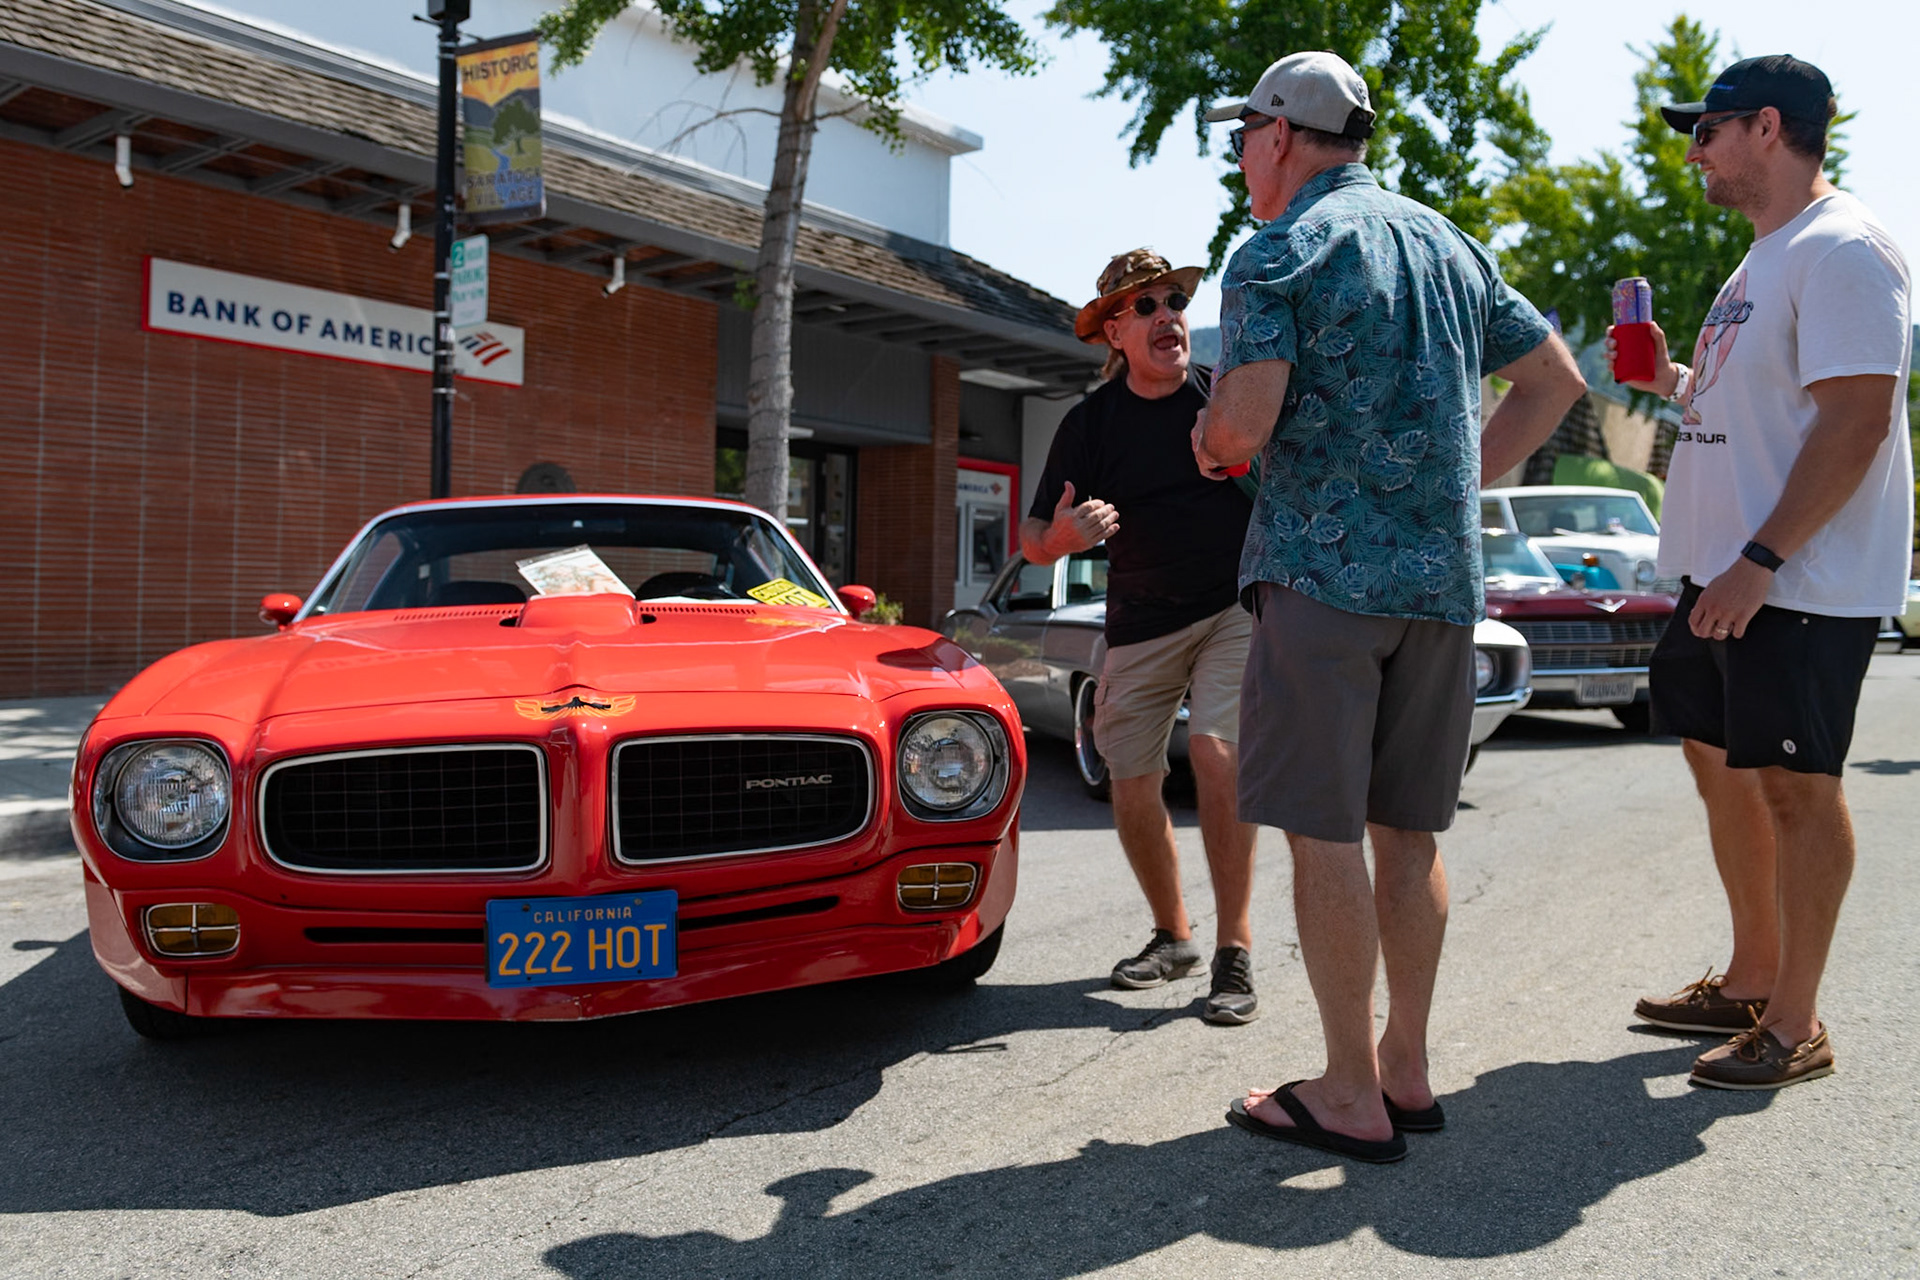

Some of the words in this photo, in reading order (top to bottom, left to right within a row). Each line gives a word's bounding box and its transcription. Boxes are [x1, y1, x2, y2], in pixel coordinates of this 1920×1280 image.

[462, 52, 537, 82] HISTORIC
[454, 245, 463, 265] 2
[167, 290, 261, 328] BANK
[272, 310, 313, 334] OF
[319, 319, 434, 357] AMERIC
[745, 774, 833, 790] PONTIAC
[533, 906, 633, 924] CALIFORNIA
[497, 930, 574, 976] 222
[588, 923, 668, 971] HOT
